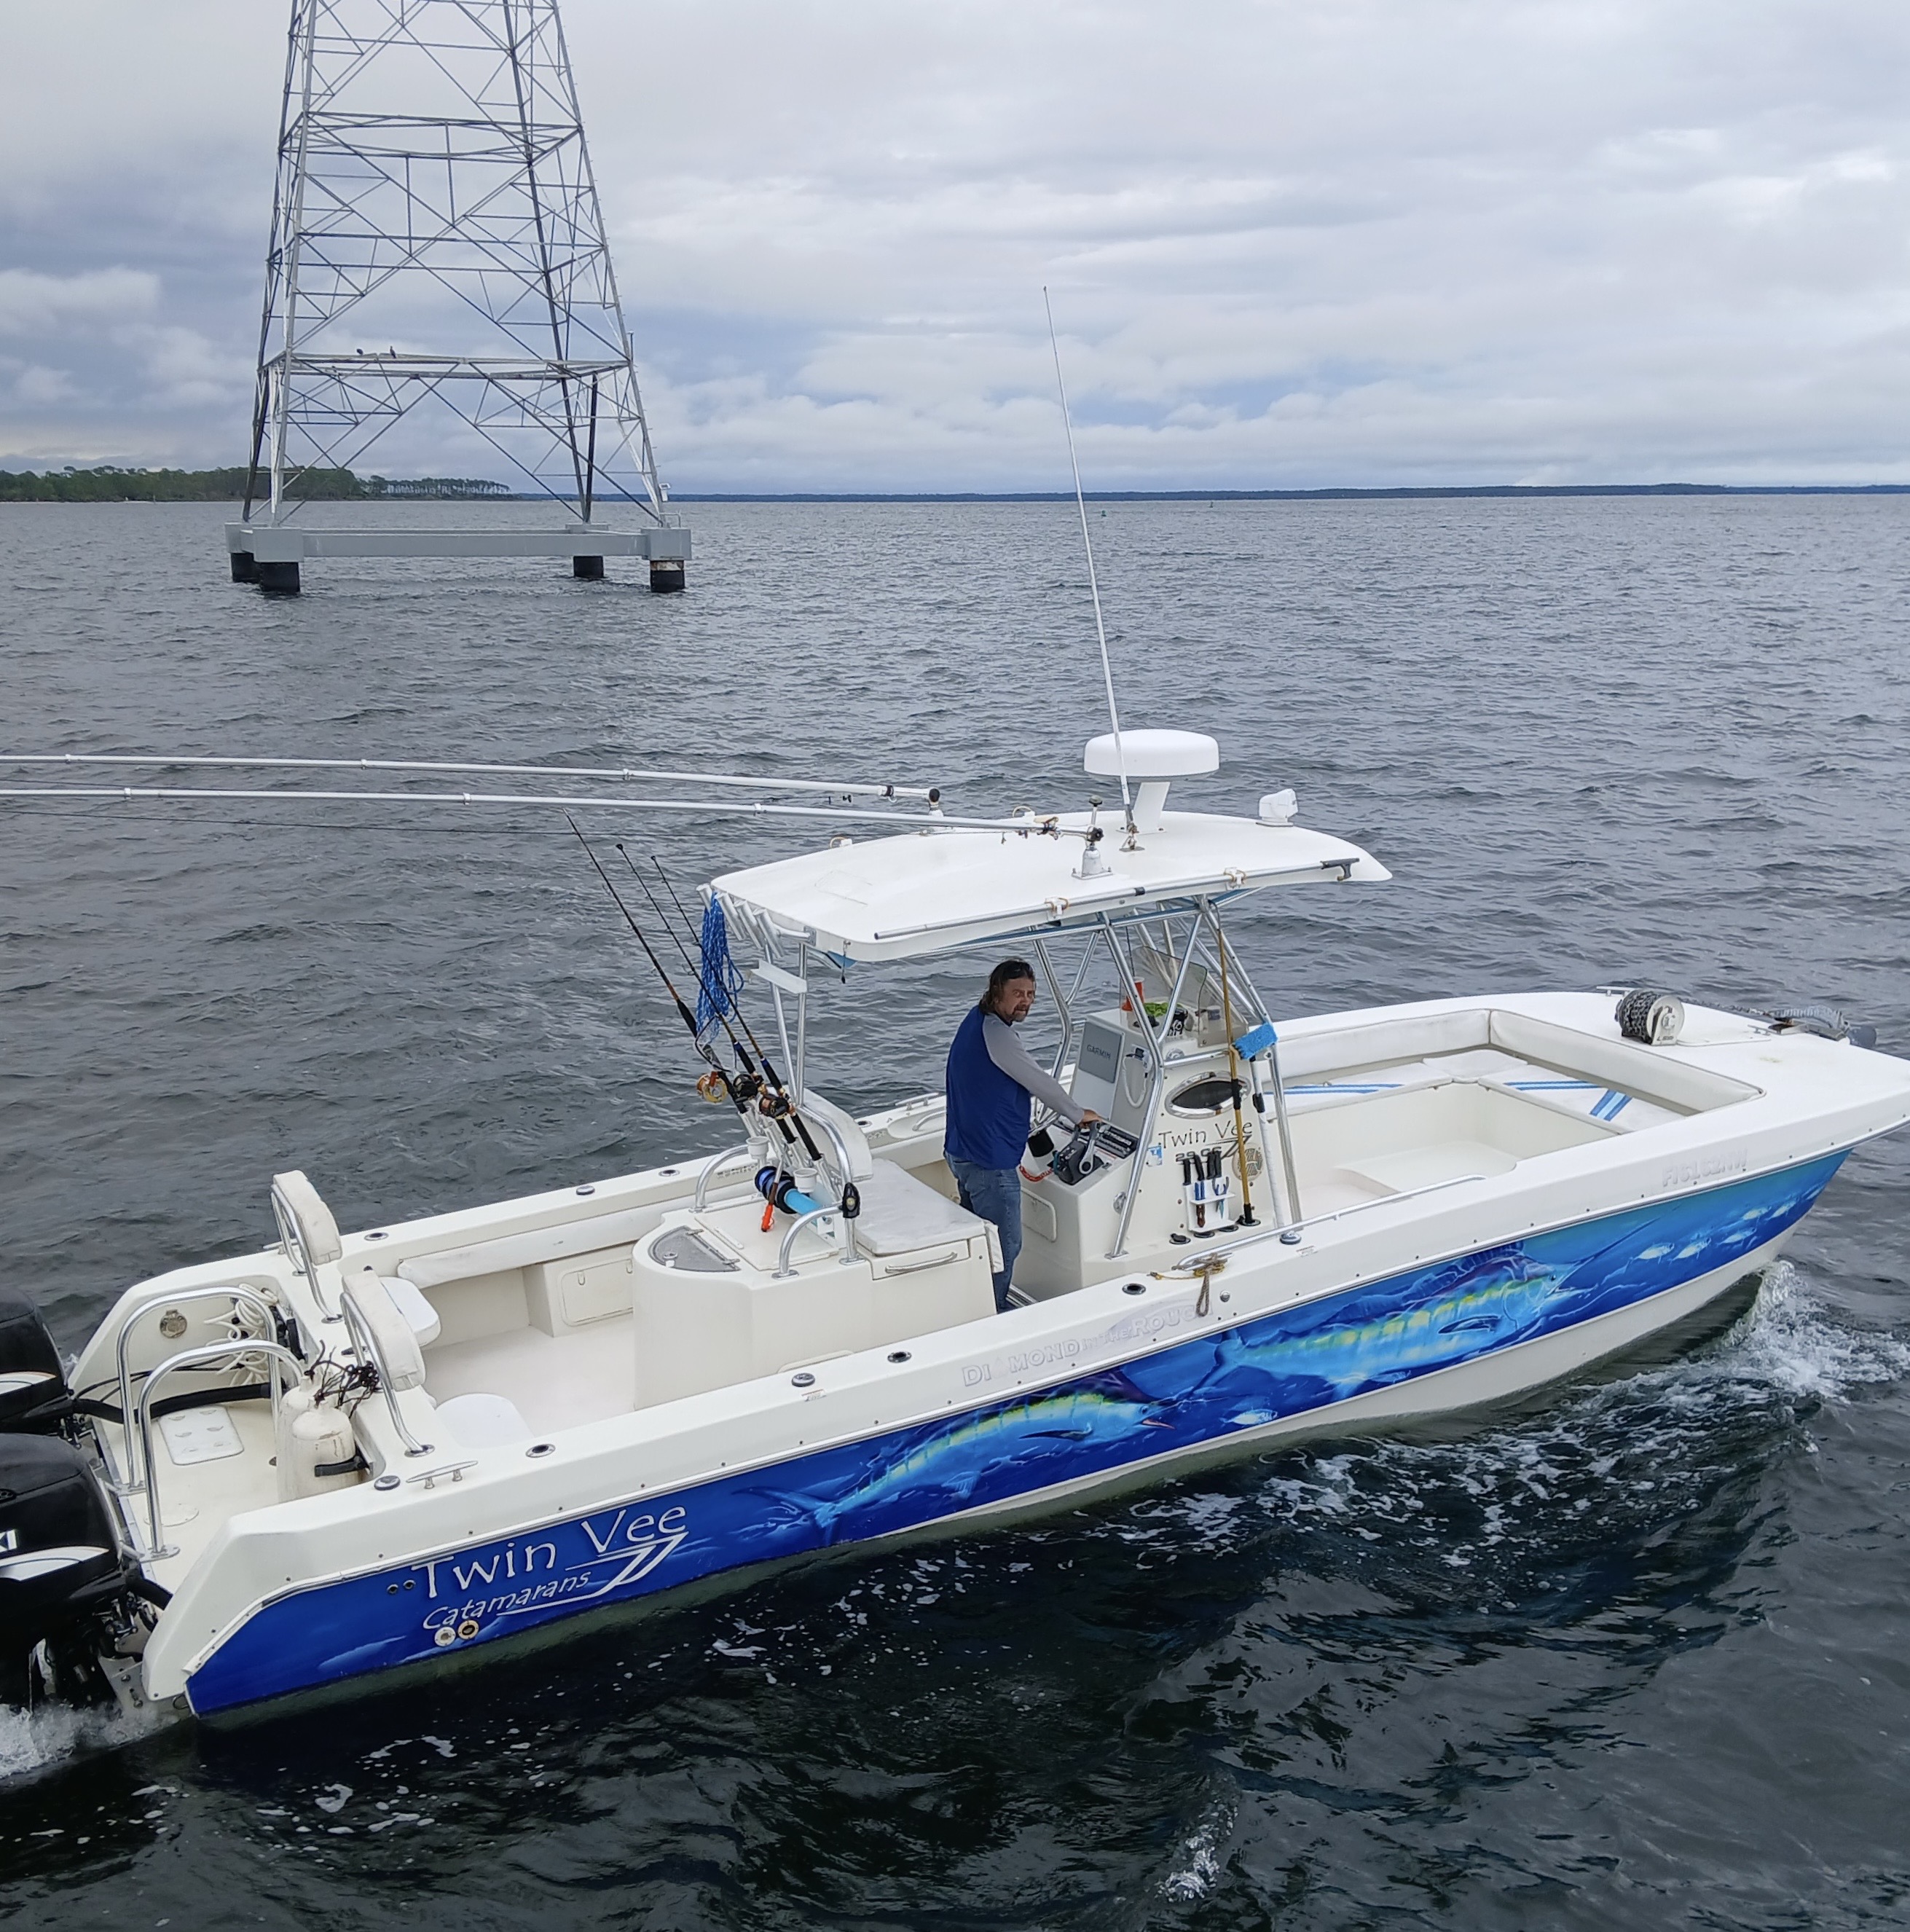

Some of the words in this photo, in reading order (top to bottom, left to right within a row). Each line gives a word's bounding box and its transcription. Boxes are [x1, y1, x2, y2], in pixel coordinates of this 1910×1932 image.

[1087, 1044, 1111, 1059] GARMIN
[1158, 1128, 1206, 1149] Twin
[1215, 1120, 1252, 1139] Vee
[1130, 1301, 1214, 1338] ROUG
[411, 1541, 556, 1598] Twin
[581, 1505, 686, 1552] Vee
[423, 1571, 592, 1630] Catamarans
